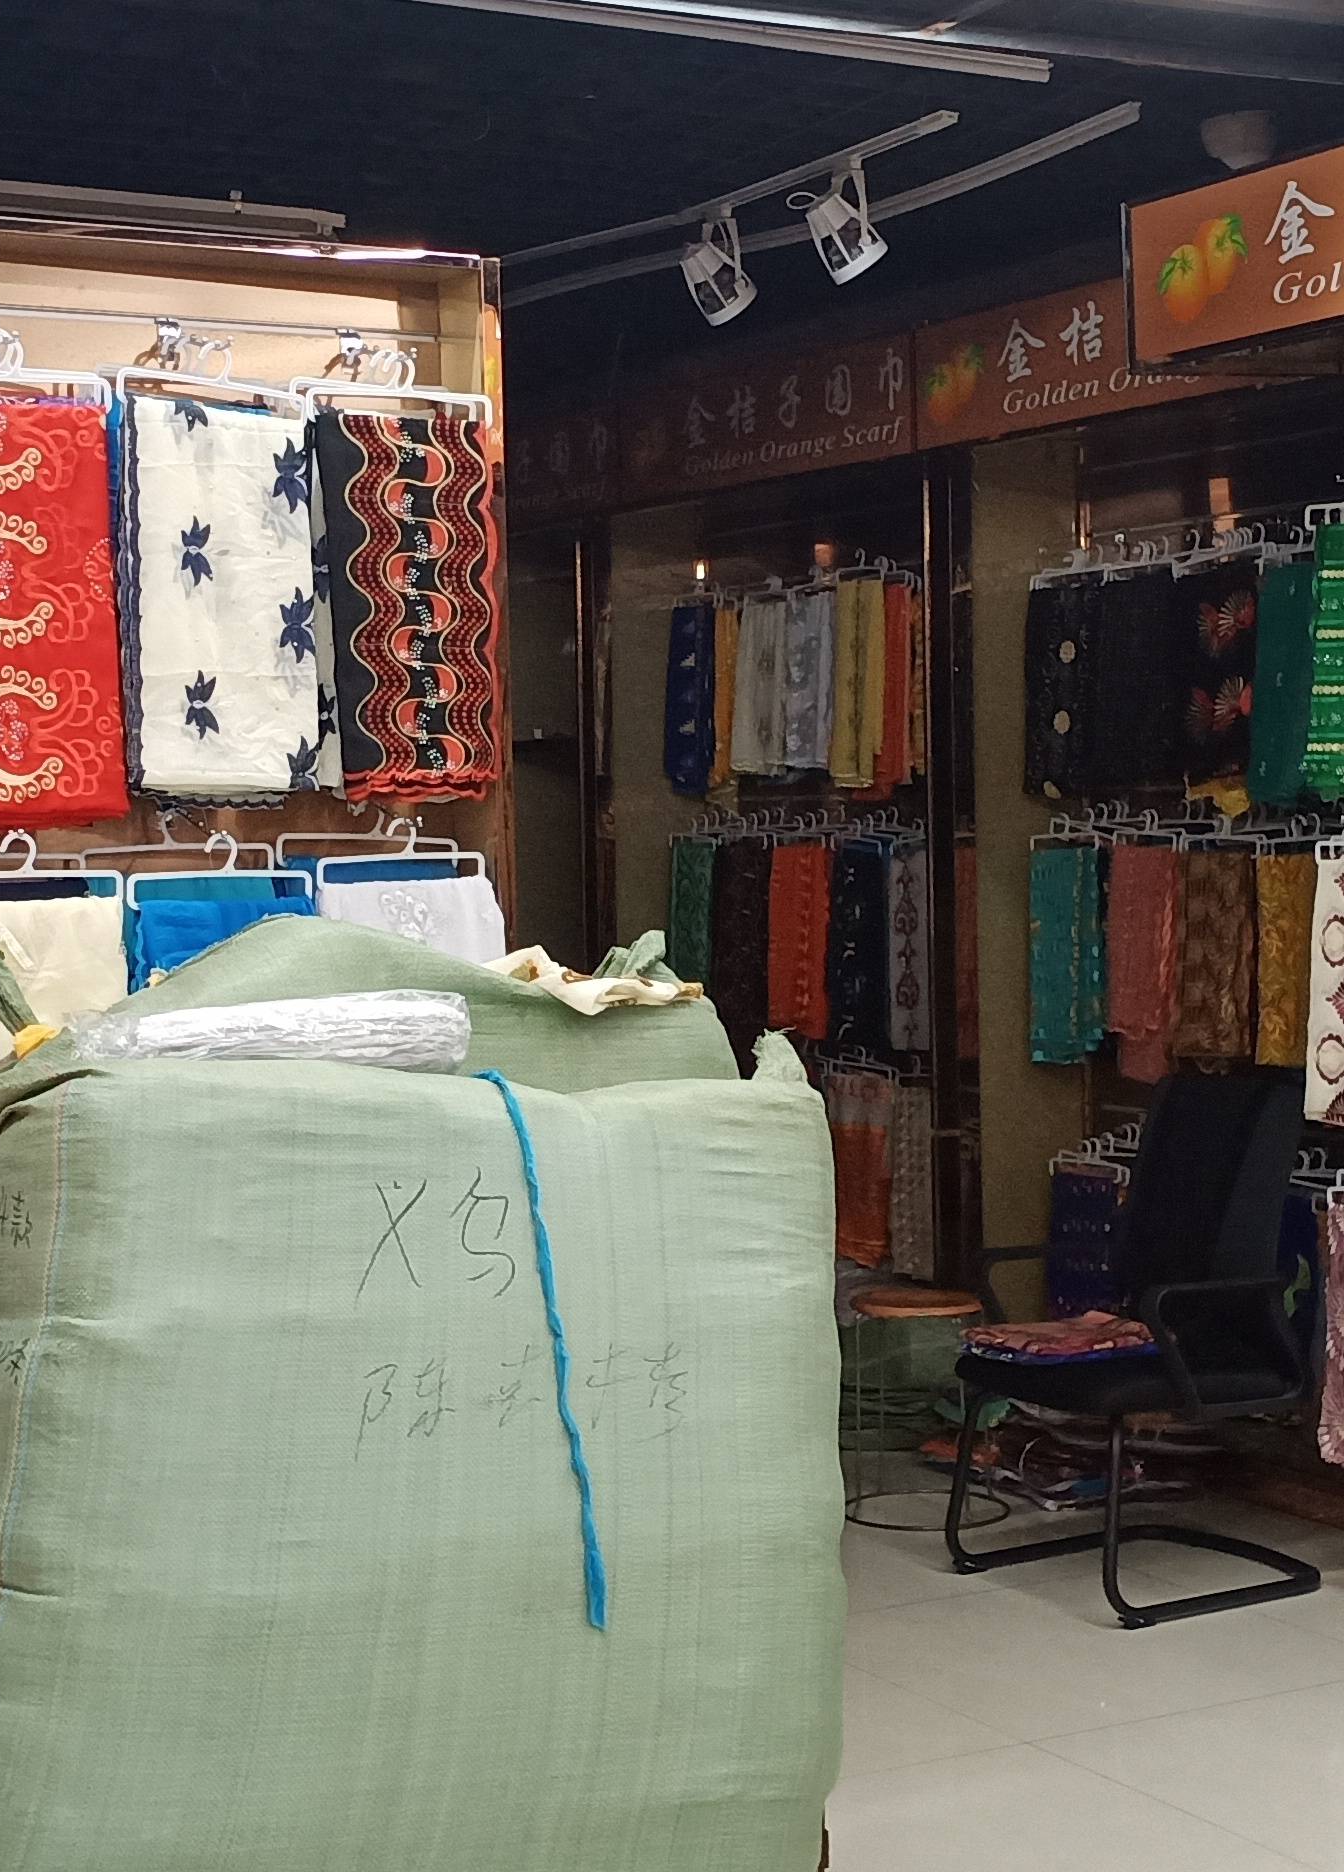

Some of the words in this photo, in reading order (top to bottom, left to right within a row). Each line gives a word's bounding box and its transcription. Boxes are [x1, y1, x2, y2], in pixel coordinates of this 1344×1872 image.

[996, 299, 1105, 384] 金桔
[1002, 379, 1099, 415] Golden
[685, 446, 754, 477] Golden
[759, 434, 838, 464] Orange
[840, 414, 906, 449] Scarf
[354, 1166, 517, 1309] 义乌
